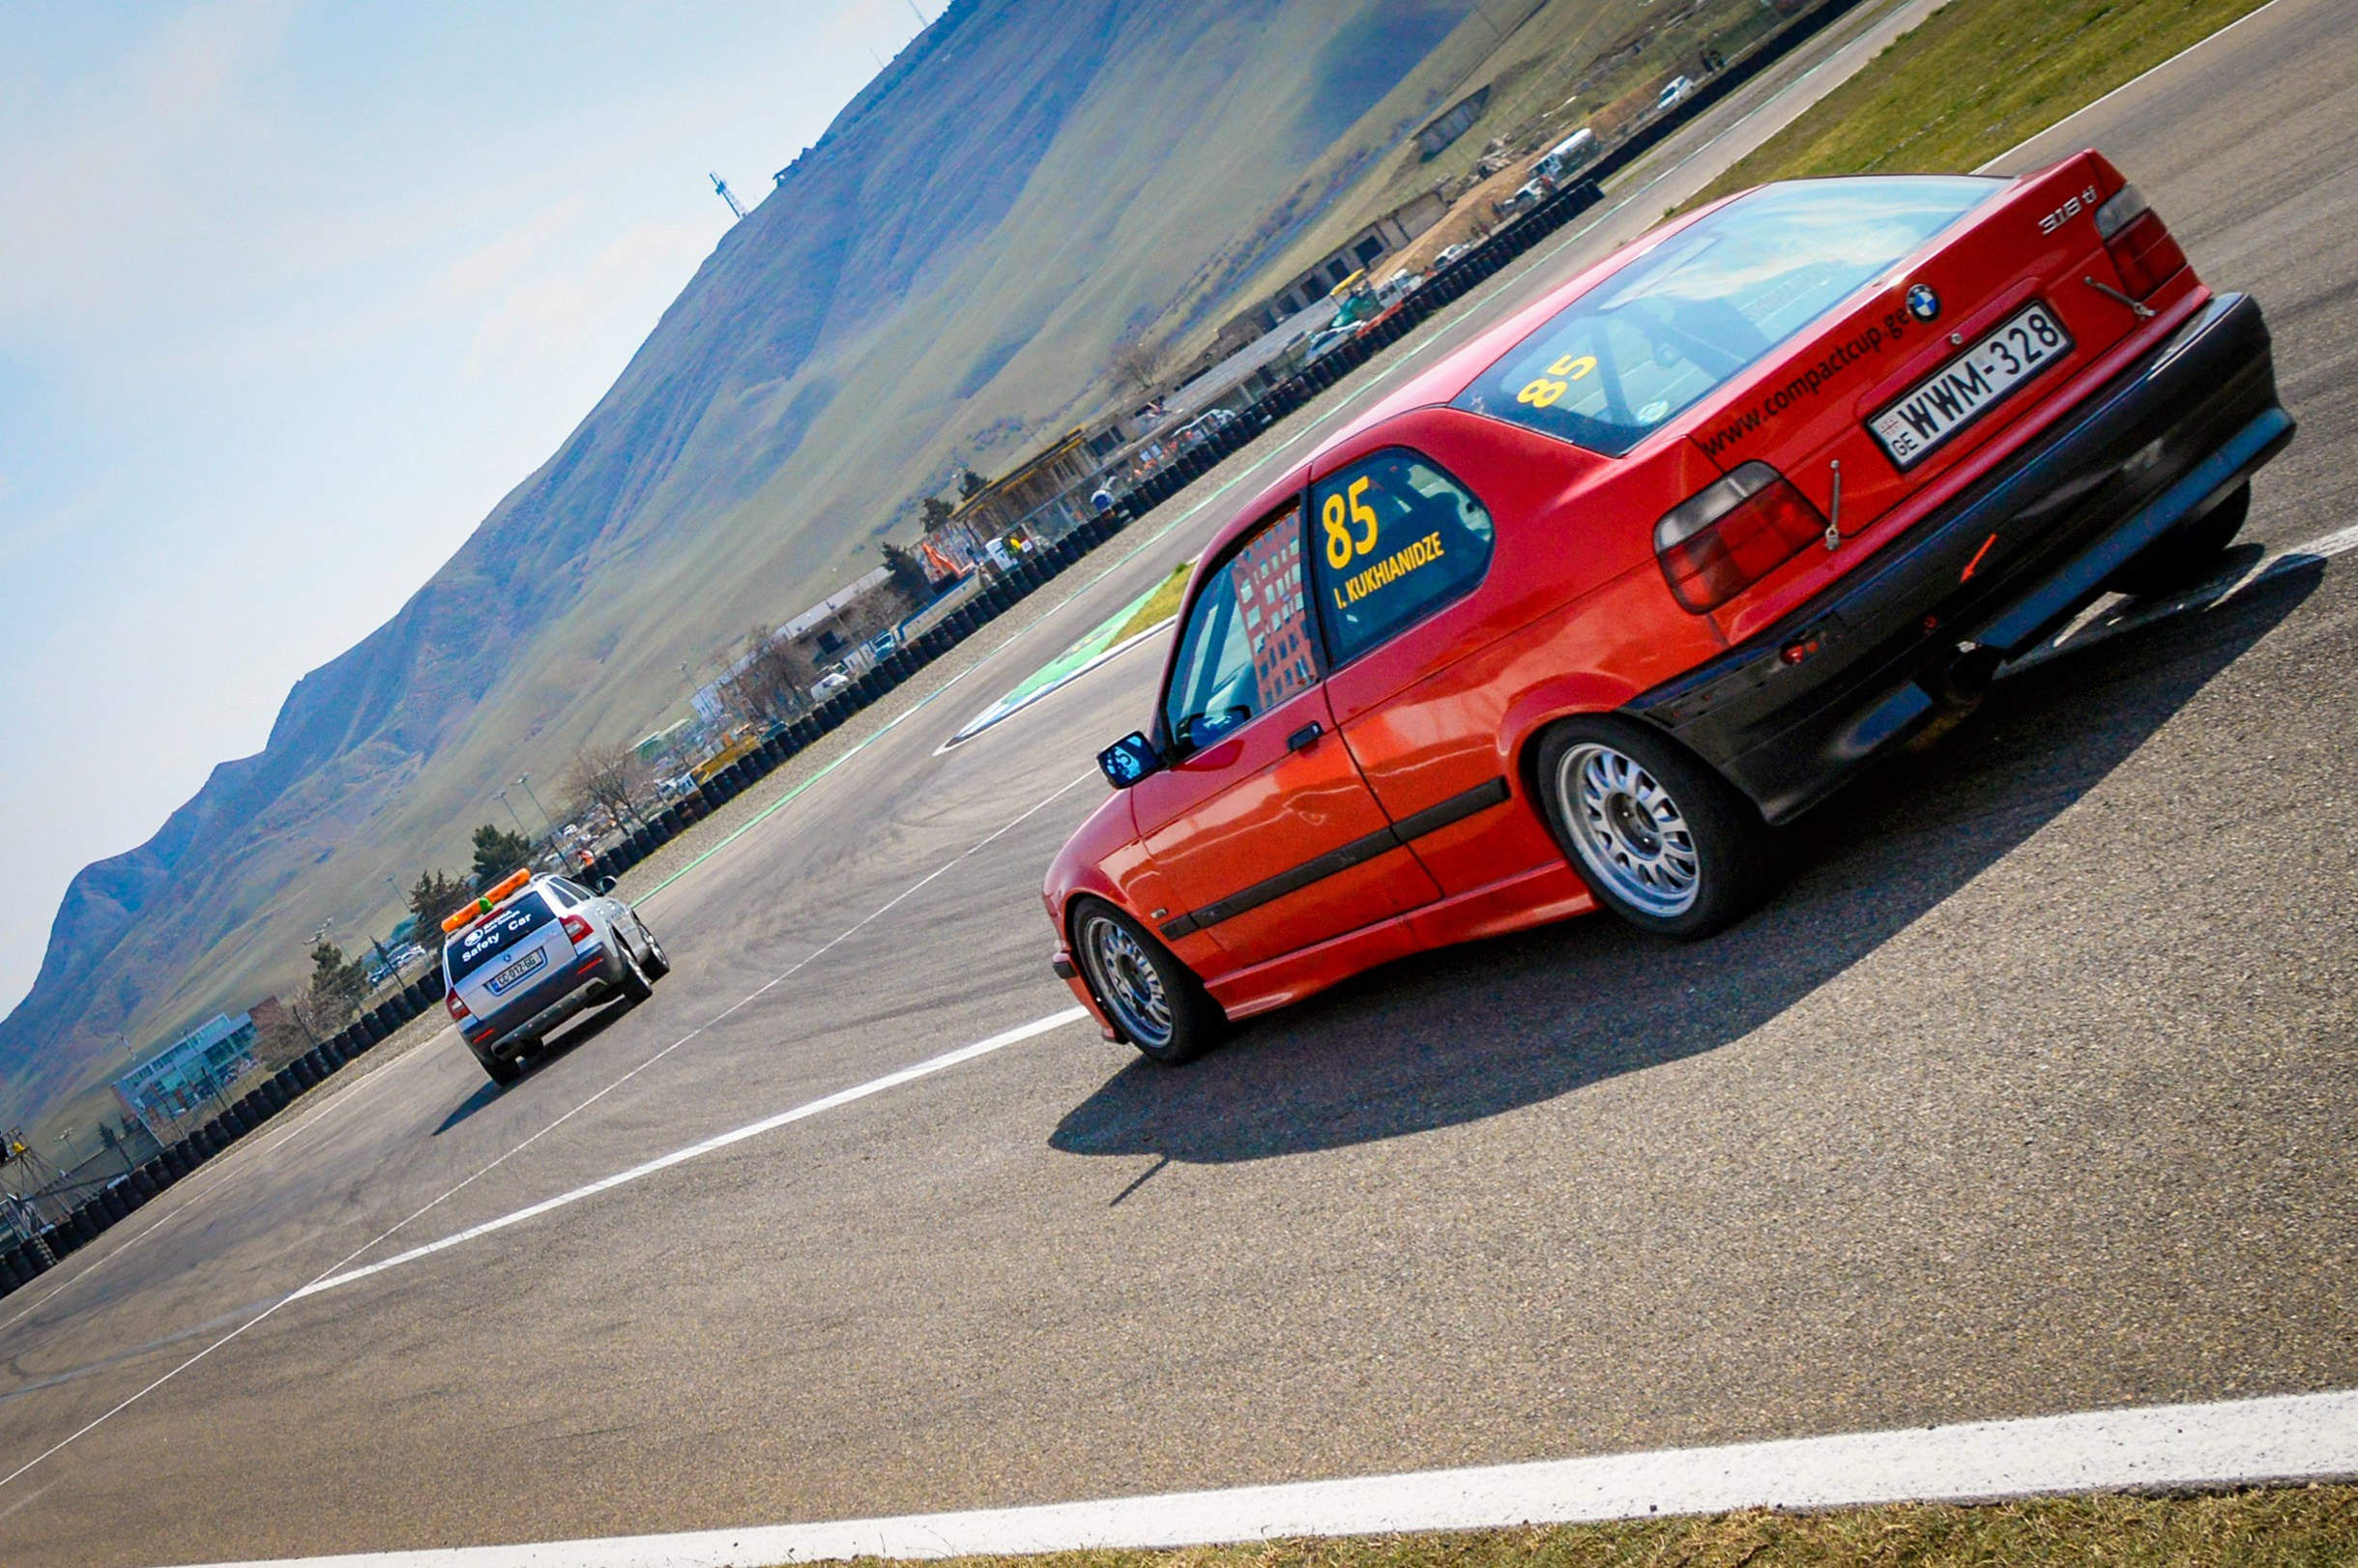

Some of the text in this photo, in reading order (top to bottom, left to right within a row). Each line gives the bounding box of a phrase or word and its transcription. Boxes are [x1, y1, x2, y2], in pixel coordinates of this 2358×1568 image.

[2038, 196, 2081, 235] 318
[1517, 355, 1597, 408] 85
[1702, 307, 1910, 455] www.compactcup.ge
[1897, 313, 2058, 440] WWM-328
[1891, 432, 1918, 456] GE
[1322, 476, 1378, 569] 85
[1345, 532, 1444, 602] KUKHIANIDZE
[462, 933, 499, 962] Safety
[509, 914, 531, 931] Car
[497, 958, 536, 985] CC-012-GG
